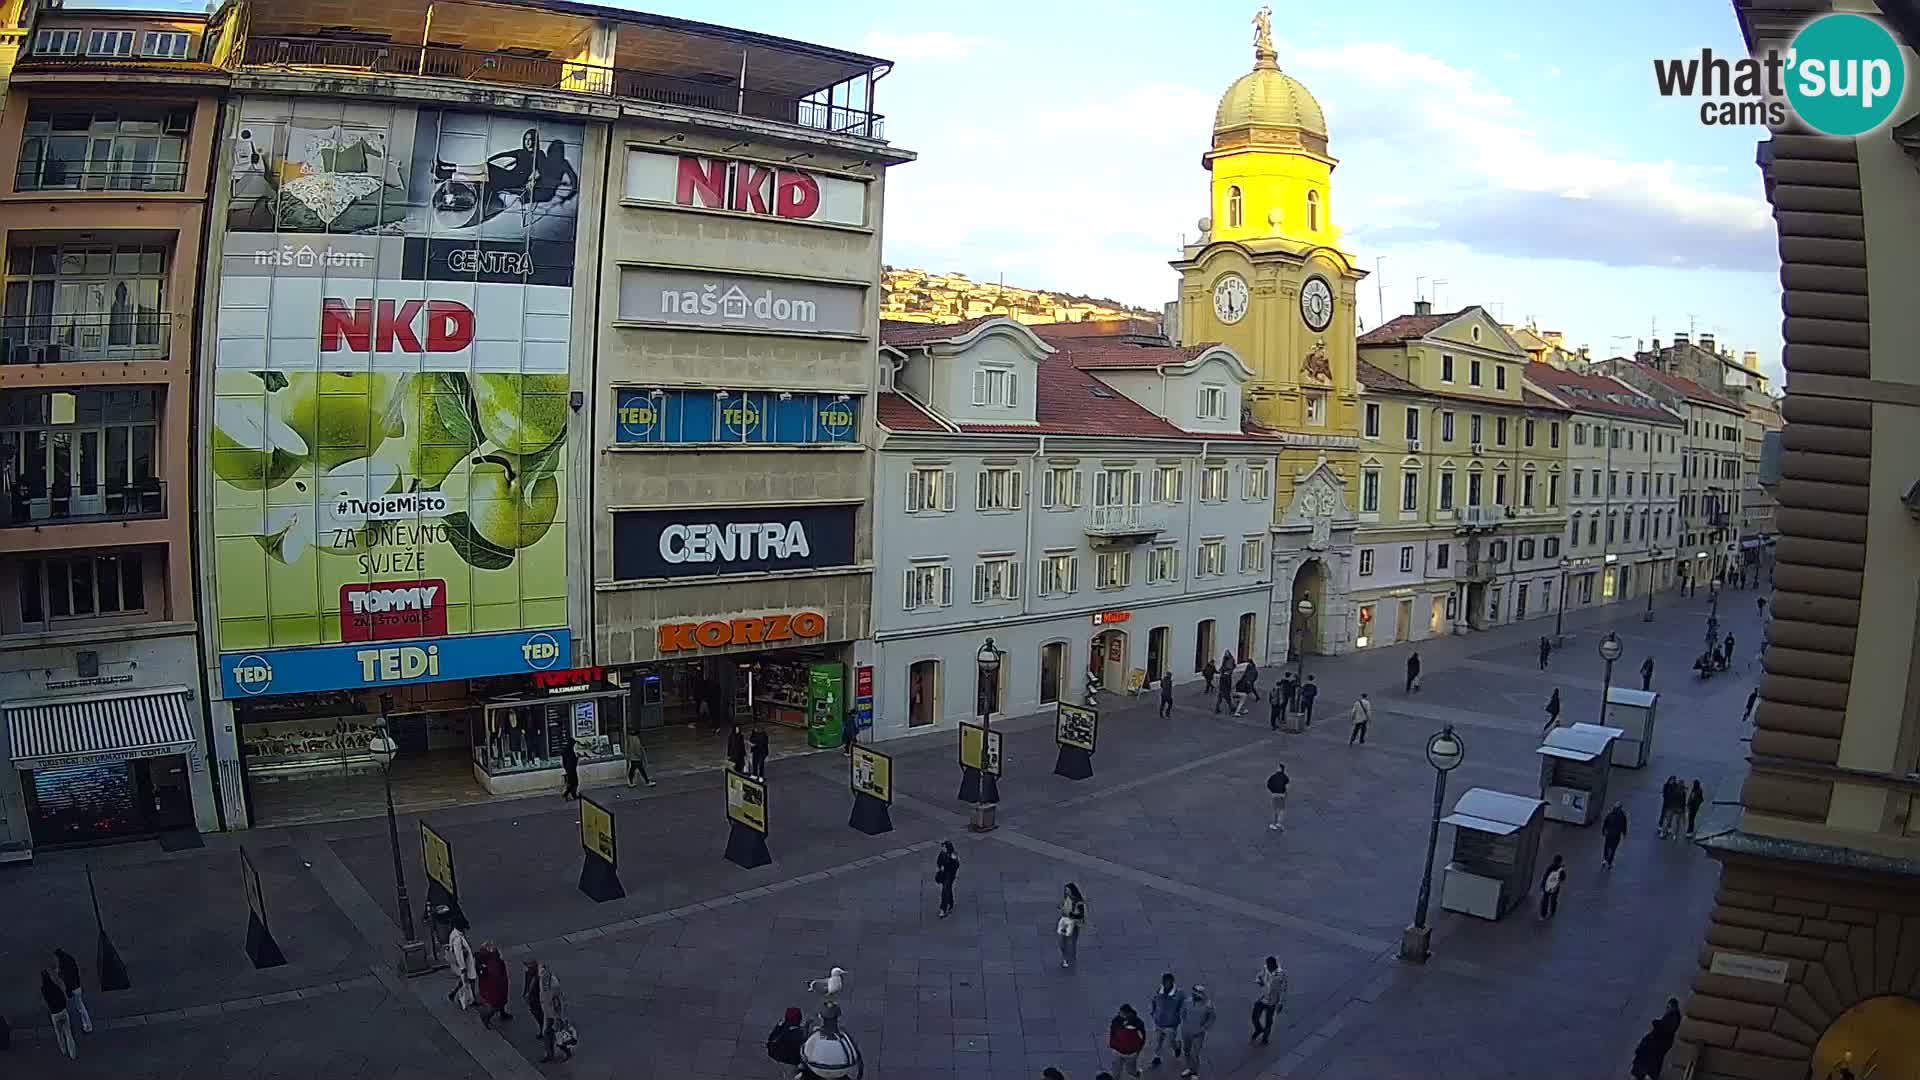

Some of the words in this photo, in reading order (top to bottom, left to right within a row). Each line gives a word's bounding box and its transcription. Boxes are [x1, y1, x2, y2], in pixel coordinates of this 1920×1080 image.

[676, 156, 821, 219] NKD
[254, 245, 294, 266] naš
[318, 246, 366, 268] dom
[448, 249, 535, 275] CENTRA
[661, 284, 718, 316] naš
[753, 289, 817, 322] dom
[320, 296, 477, 354] NKD
[618, 406, 657, 425] TEDi
[723, 408, 760, 425] TEDi
[819, 411, 853, 427] TEDi
[337, 496, 446, 516] #TvojeMisto
[333, 528, 357, 549] ZA
[365, 523, 450, 548] DNEVNO
[659, 520, 810, 564] CENTRA
[358, 546, 425, 575] SVJEŽE
[348, 585, 438, 614] TOMMY
[658, 612, 825, 652] KORZO
[357, 643, 440, 682] TEDi
[521, 642, 560, 661] TEDi
[232, 664, 273, 684] TEDi
